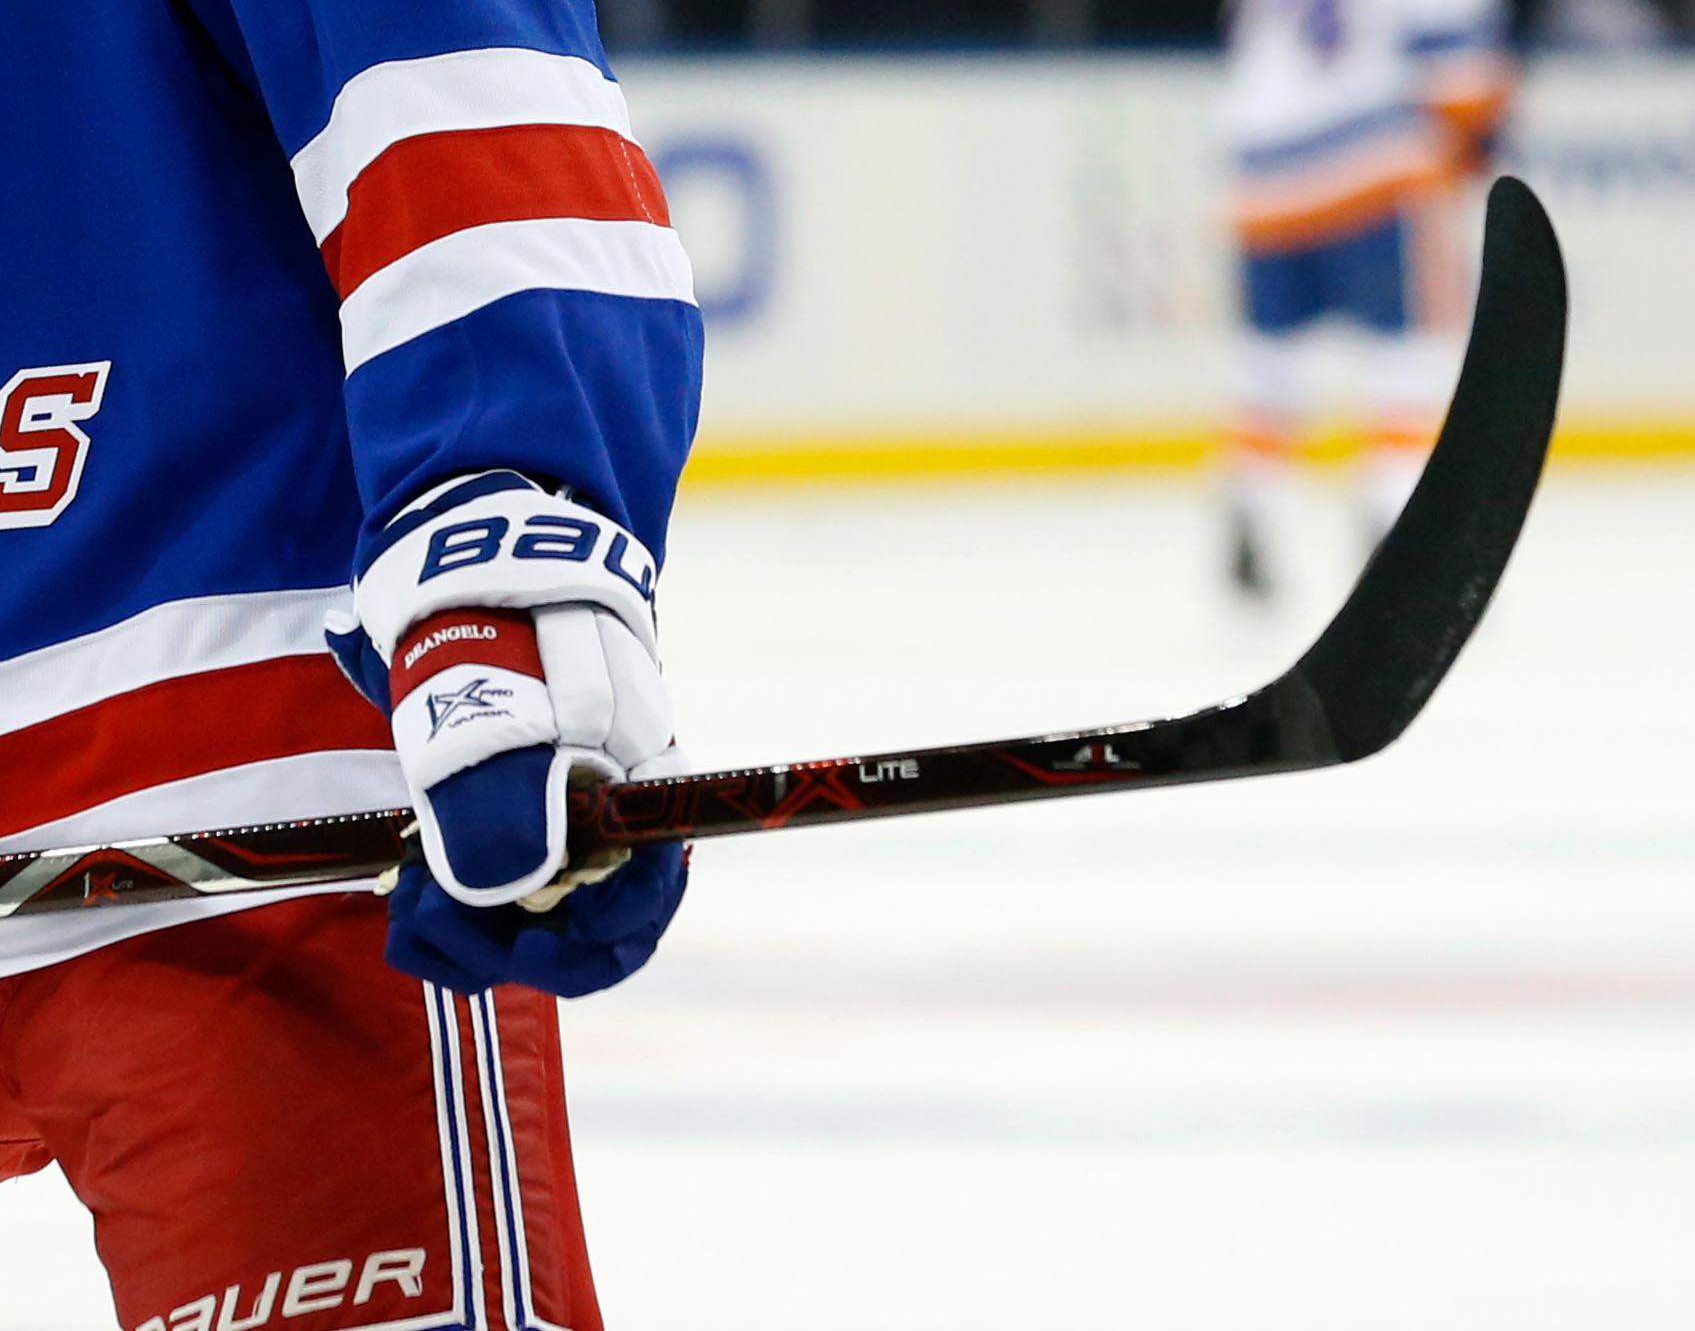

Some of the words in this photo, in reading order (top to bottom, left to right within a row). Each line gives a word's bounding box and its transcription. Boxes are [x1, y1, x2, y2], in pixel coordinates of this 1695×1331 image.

[403, 623, 498, 671] DEANGELO
[858, 758, 920, 784] LITE
[135, 1247, 427, 1331] AUER
